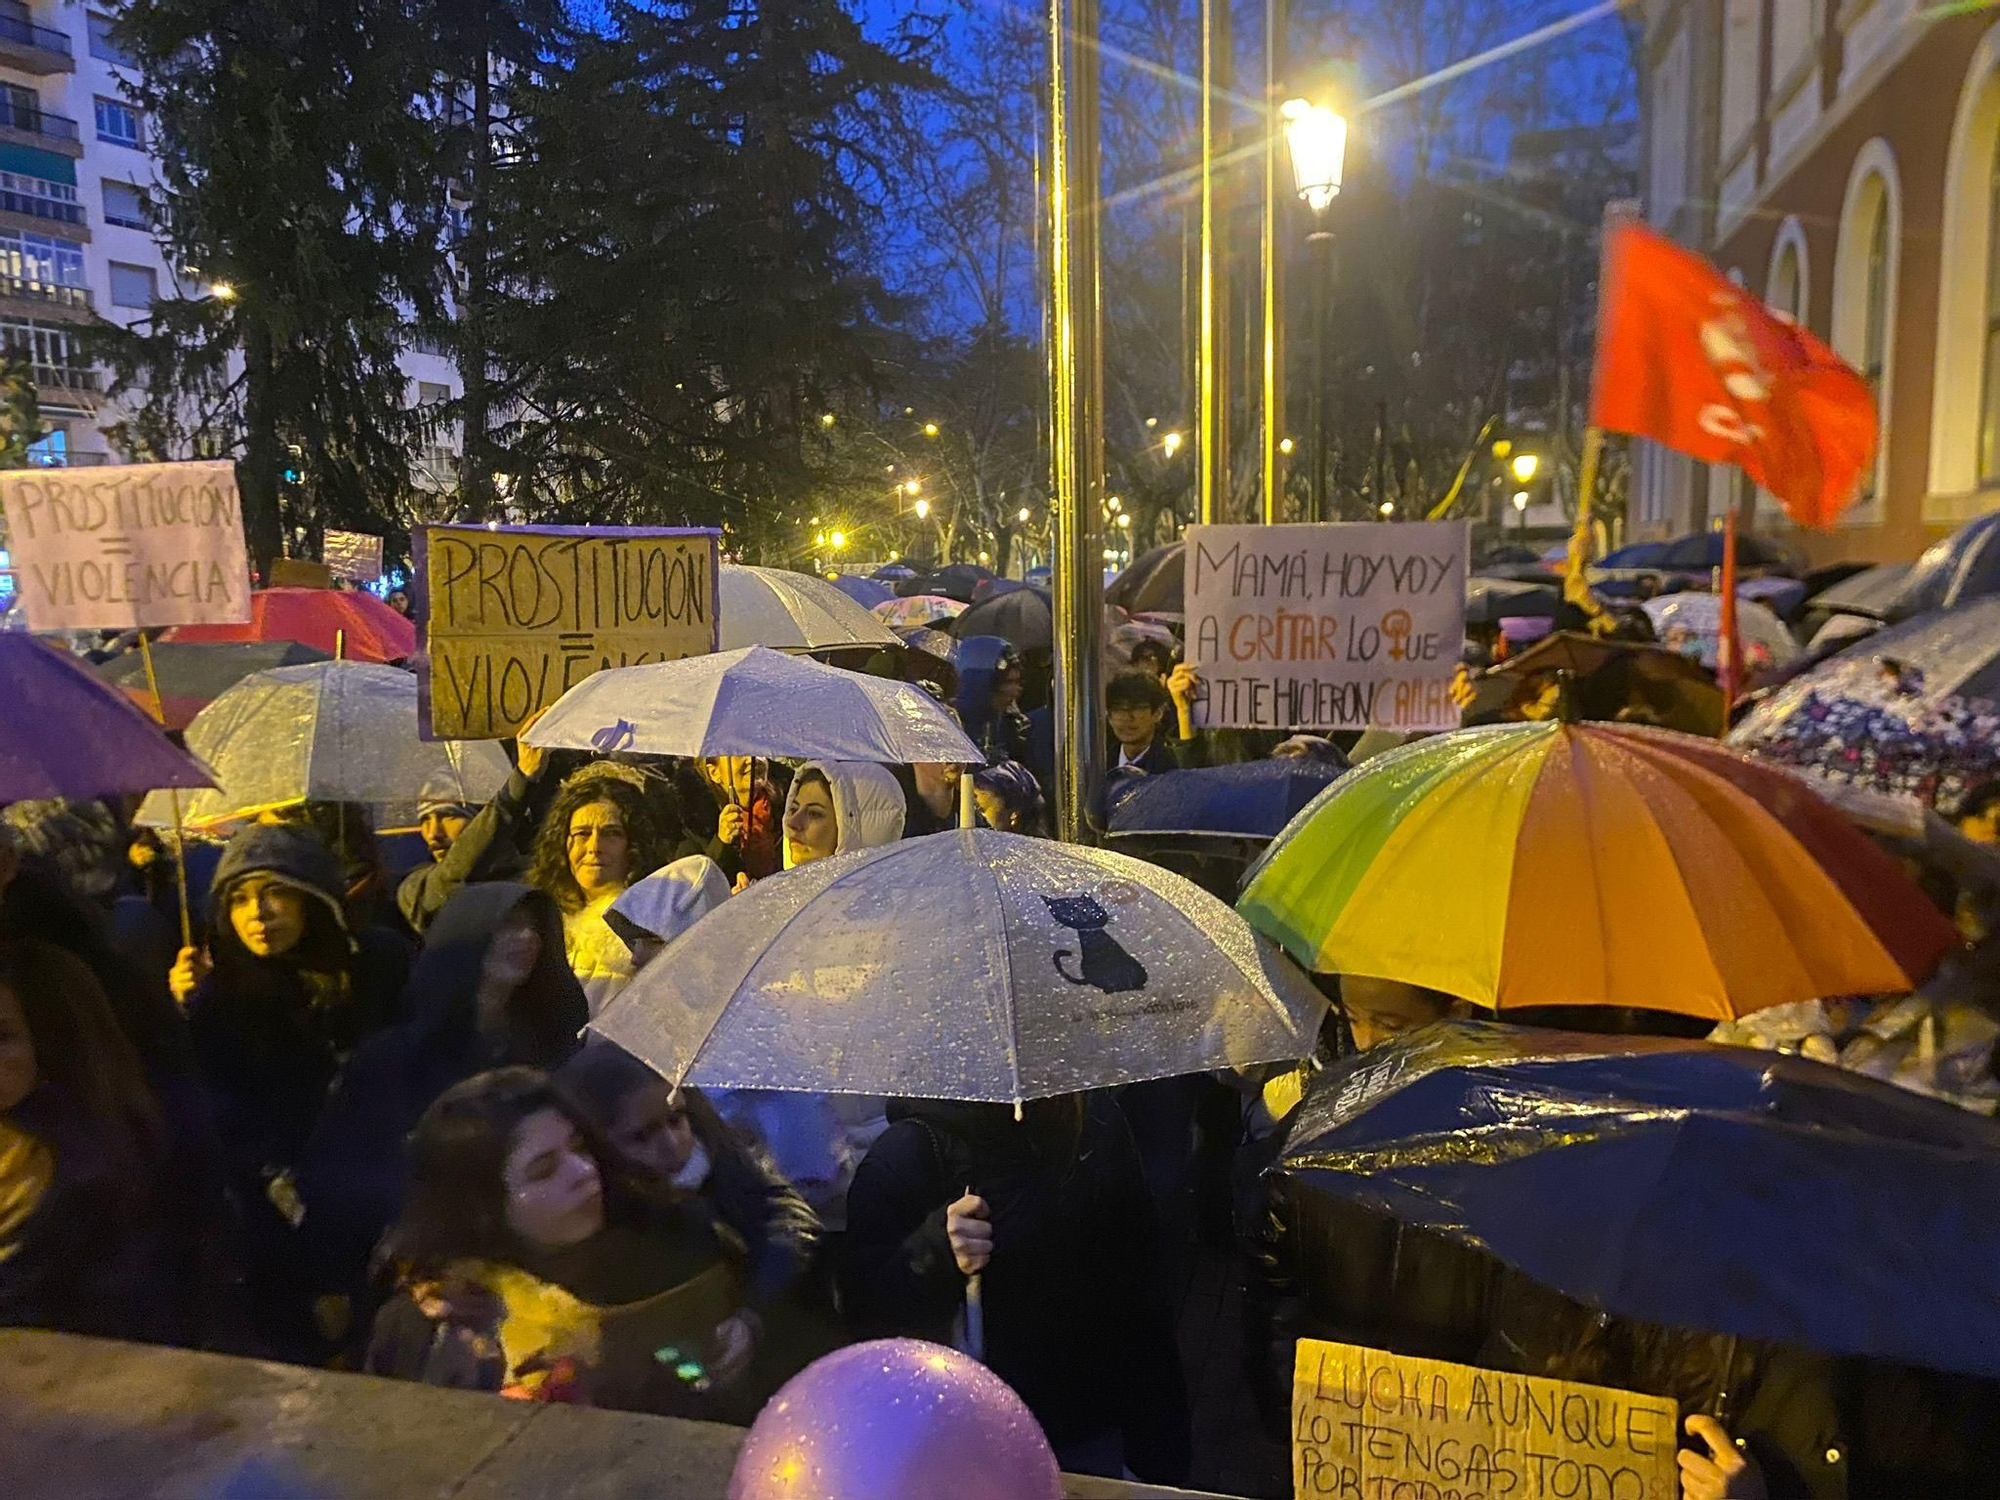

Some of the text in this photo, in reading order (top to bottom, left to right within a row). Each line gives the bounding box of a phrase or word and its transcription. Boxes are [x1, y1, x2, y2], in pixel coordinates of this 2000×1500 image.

[12, 473, 235, 539] PROSTITUCIÓN
[32, 559, 232, 607] VIOLENCIA
[436, 537, 705, 631] PROSTITUCIÓN
[1321, 552, 1384, 599] HOY
[1388, 553, 1455, 595] VOY
[1198, 615, 1219, 662] A
[1346, 615, 1381, 662] LO
[1190, 678, 1211, 724] A
[1241, 677, 1270, 725] TE
[1273, 677, 1375, 726] HICIERON
[1315, 1352, 1667, 1455] LUCHA AUNQUE
[1296, 1404, 1332, 1444] LO
[1341, 1422, 1518, 1494] TENGAS
[1302, 1447, 1363, 1500] POR
